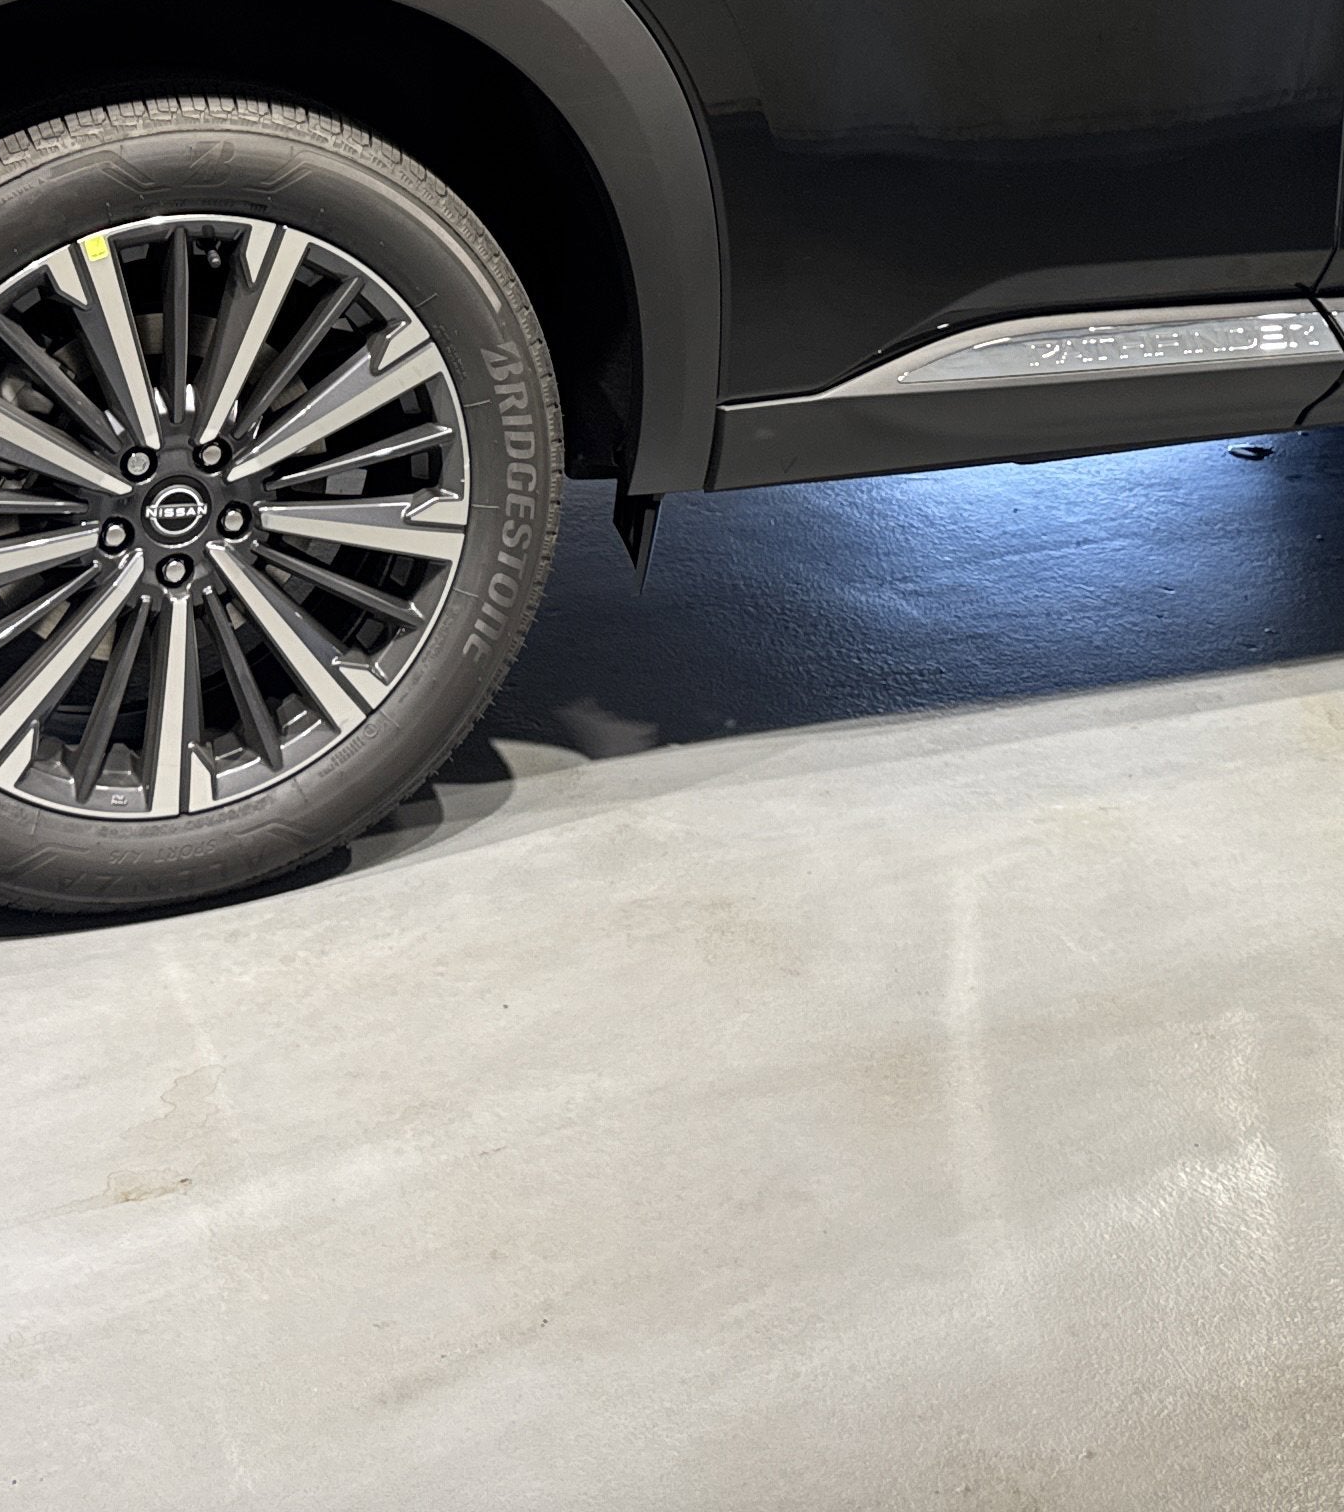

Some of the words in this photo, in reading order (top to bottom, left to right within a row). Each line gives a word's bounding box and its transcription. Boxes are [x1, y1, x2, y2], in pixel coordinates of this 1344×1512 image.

[1029, 324, 1322, 367] PATHFINDER
[145, 503, 208, 518] NISSAN
[462, 340, 538, 665] BRIDGESTONE
